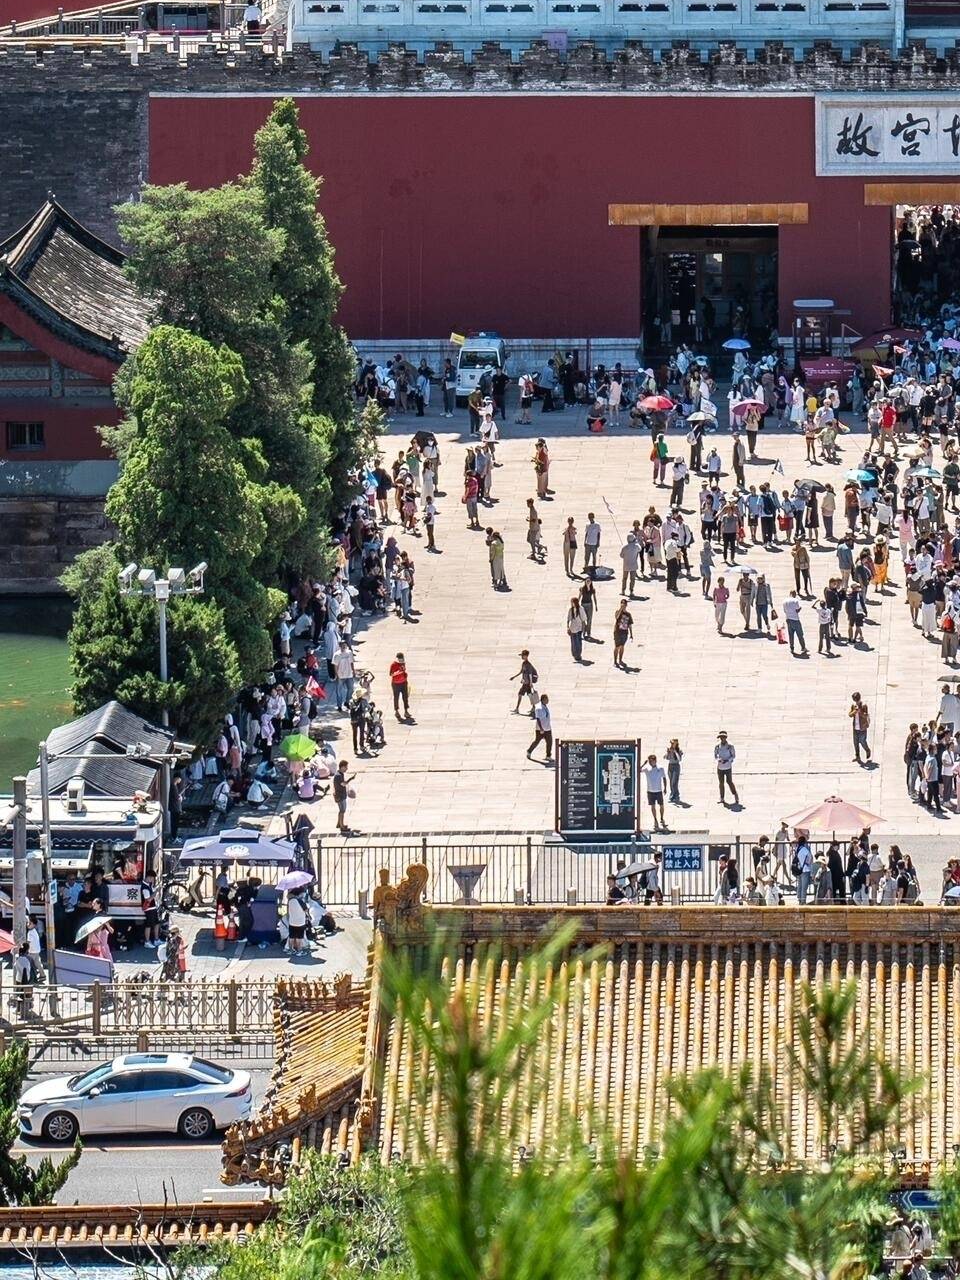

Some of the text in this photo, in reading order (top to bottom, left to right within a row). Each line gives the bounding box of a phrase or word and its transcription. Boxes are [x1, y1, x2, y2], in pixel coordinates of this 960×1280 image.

[664, 849, 701, 859] 外部车辆
[664, 859, 700, 869] 禁止入内
